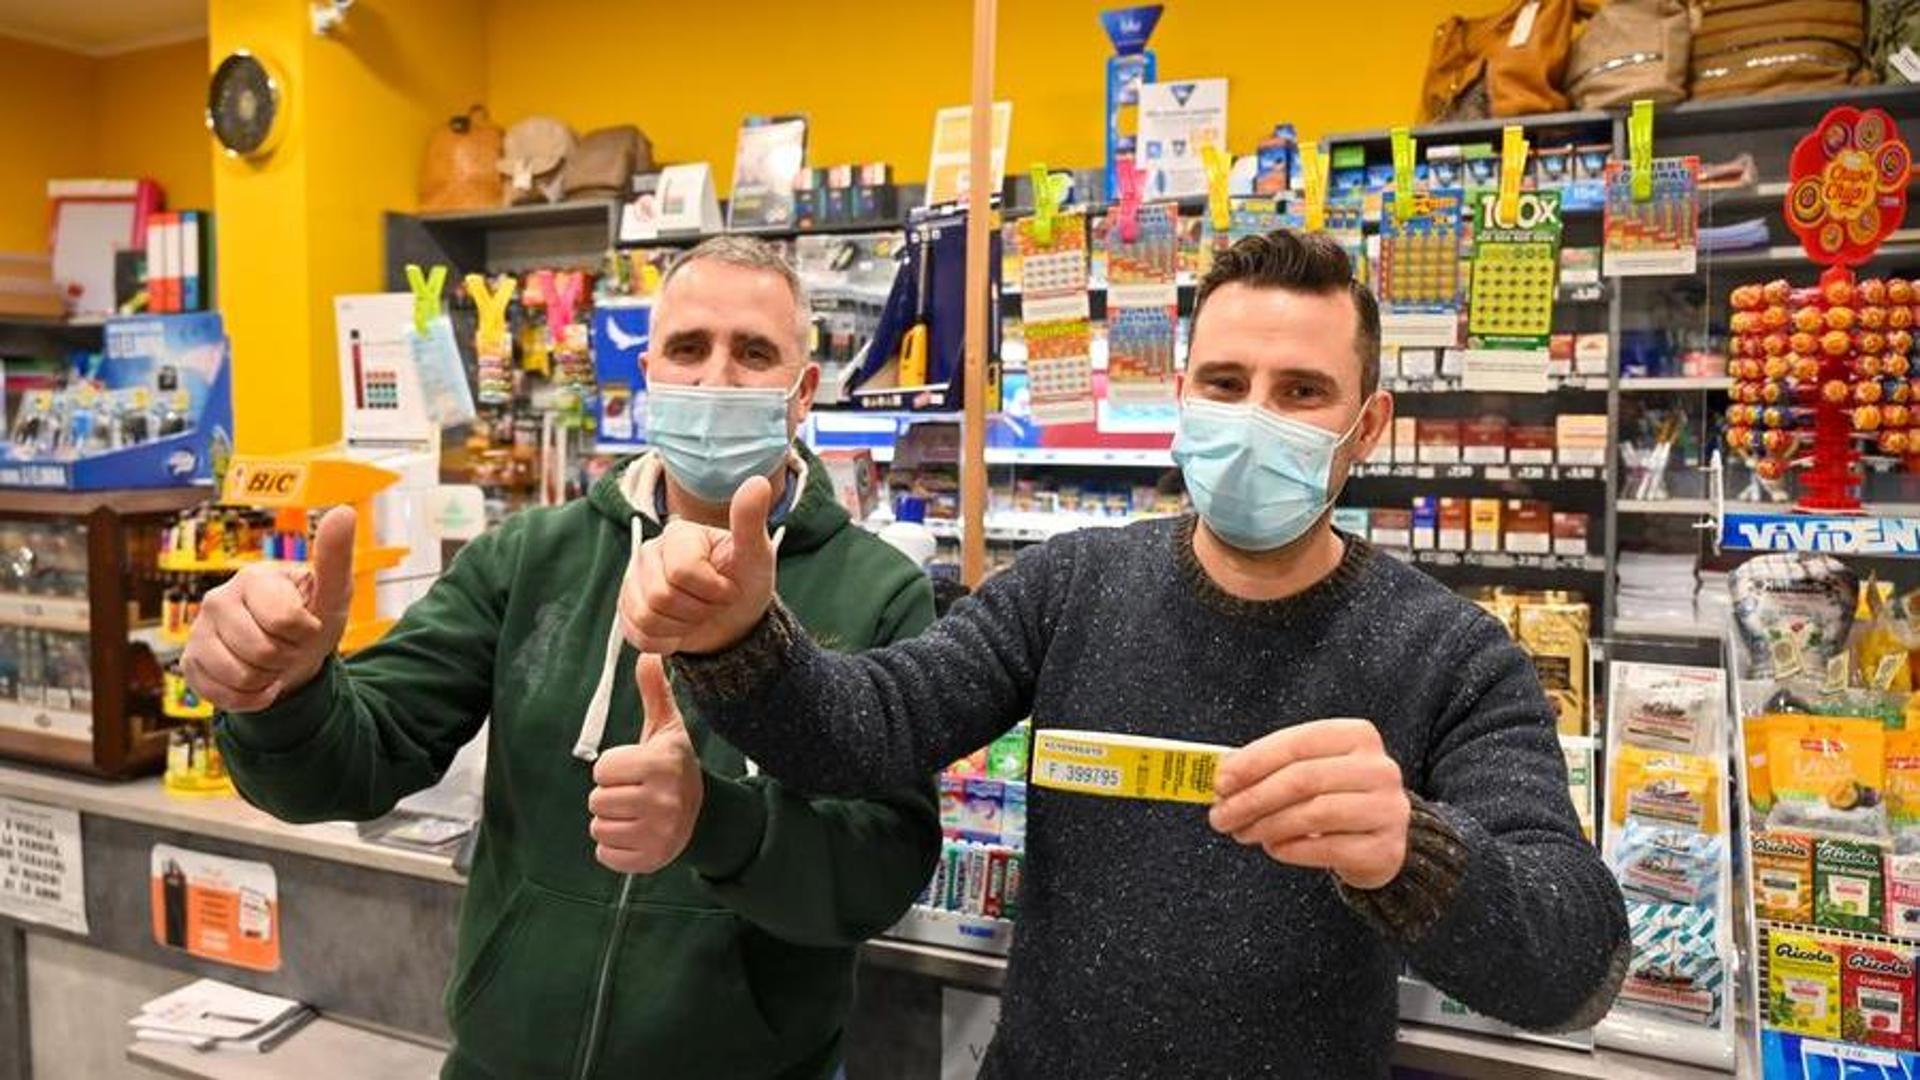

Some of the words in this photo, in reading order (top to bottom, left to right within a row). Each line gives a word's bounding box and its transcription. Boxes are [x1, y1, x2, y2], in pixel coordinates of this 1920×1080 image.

[1066, 765, 1120, 787] 399795
[1776, 943, 1834, 964] Ricola
[1849, 954, 1909, 976] Ricola
